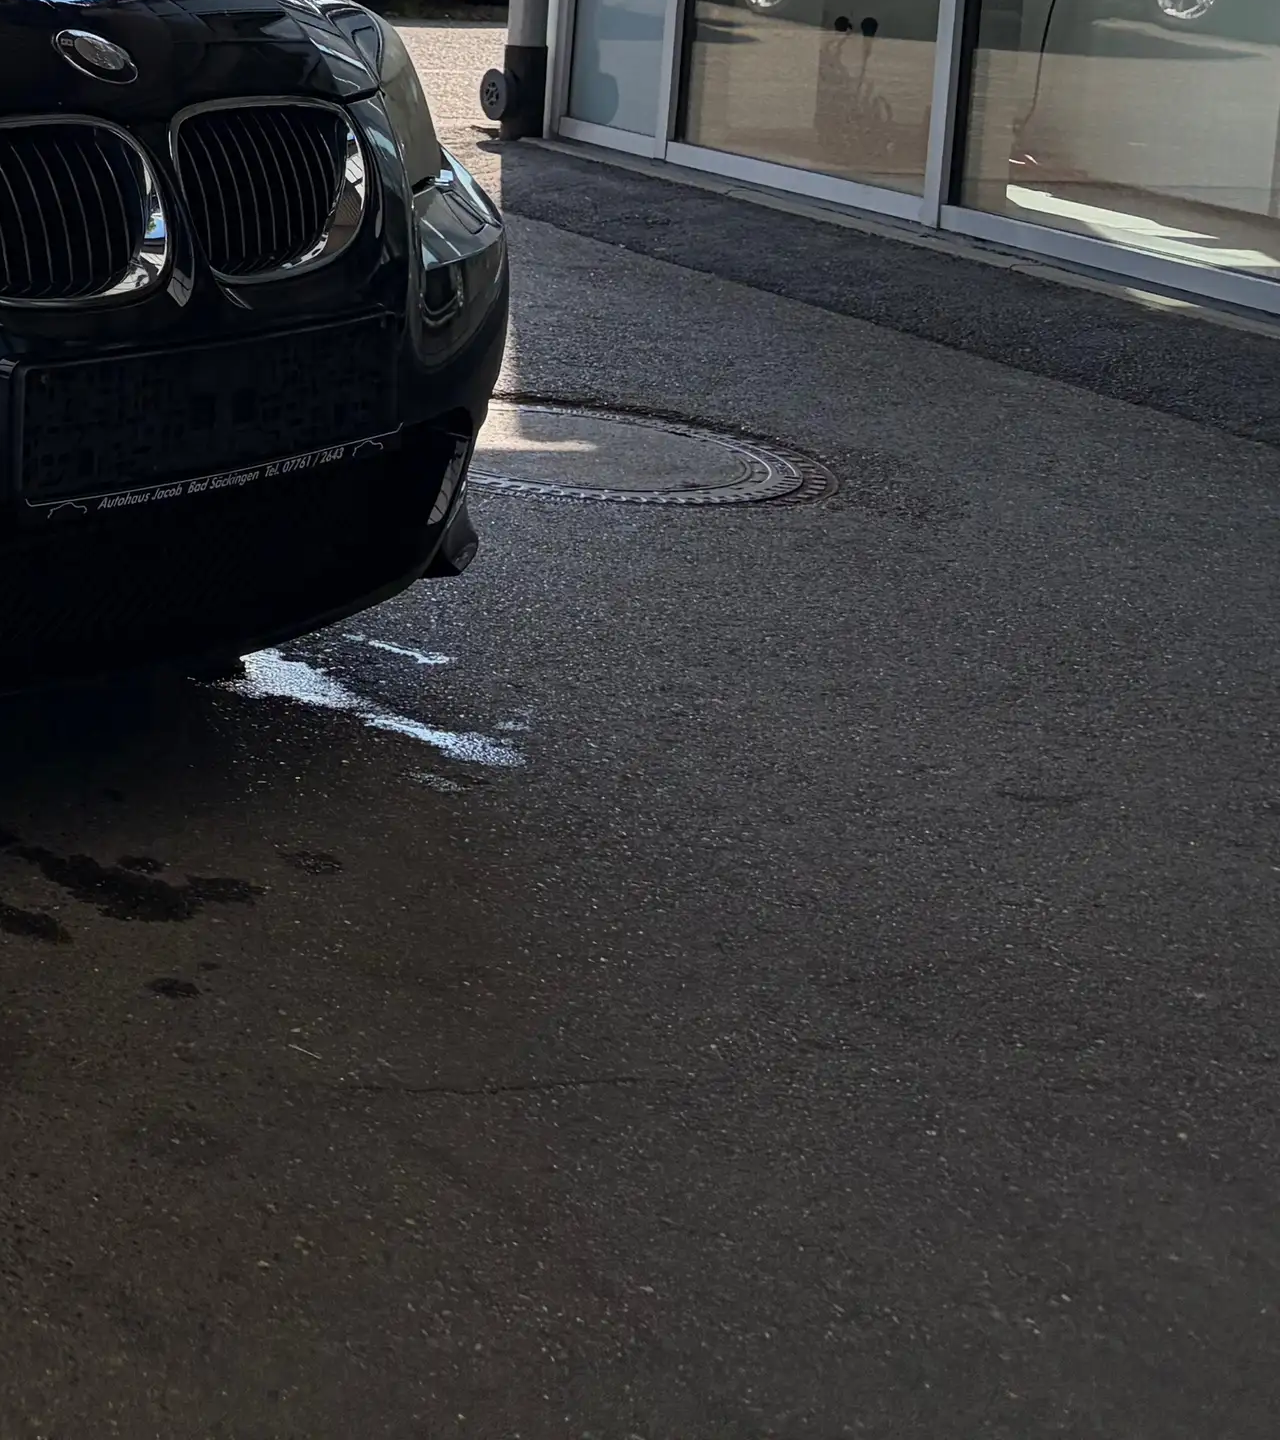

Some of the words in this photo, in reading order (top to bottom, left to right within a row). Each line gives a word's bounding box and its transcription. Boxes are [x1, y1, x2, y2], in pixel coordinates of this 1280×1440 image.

[96, 491, 151, 511] Autohaus
[151, 483, 183, 501] Jacob
[187, 477, 209, 494] Bad
[209, 470, 260, 491] Säckingen
[264, 463, 280, 478] Tel.
[282, 456, 312, 473] 07761
[320, 447, 345, 463] 2643
